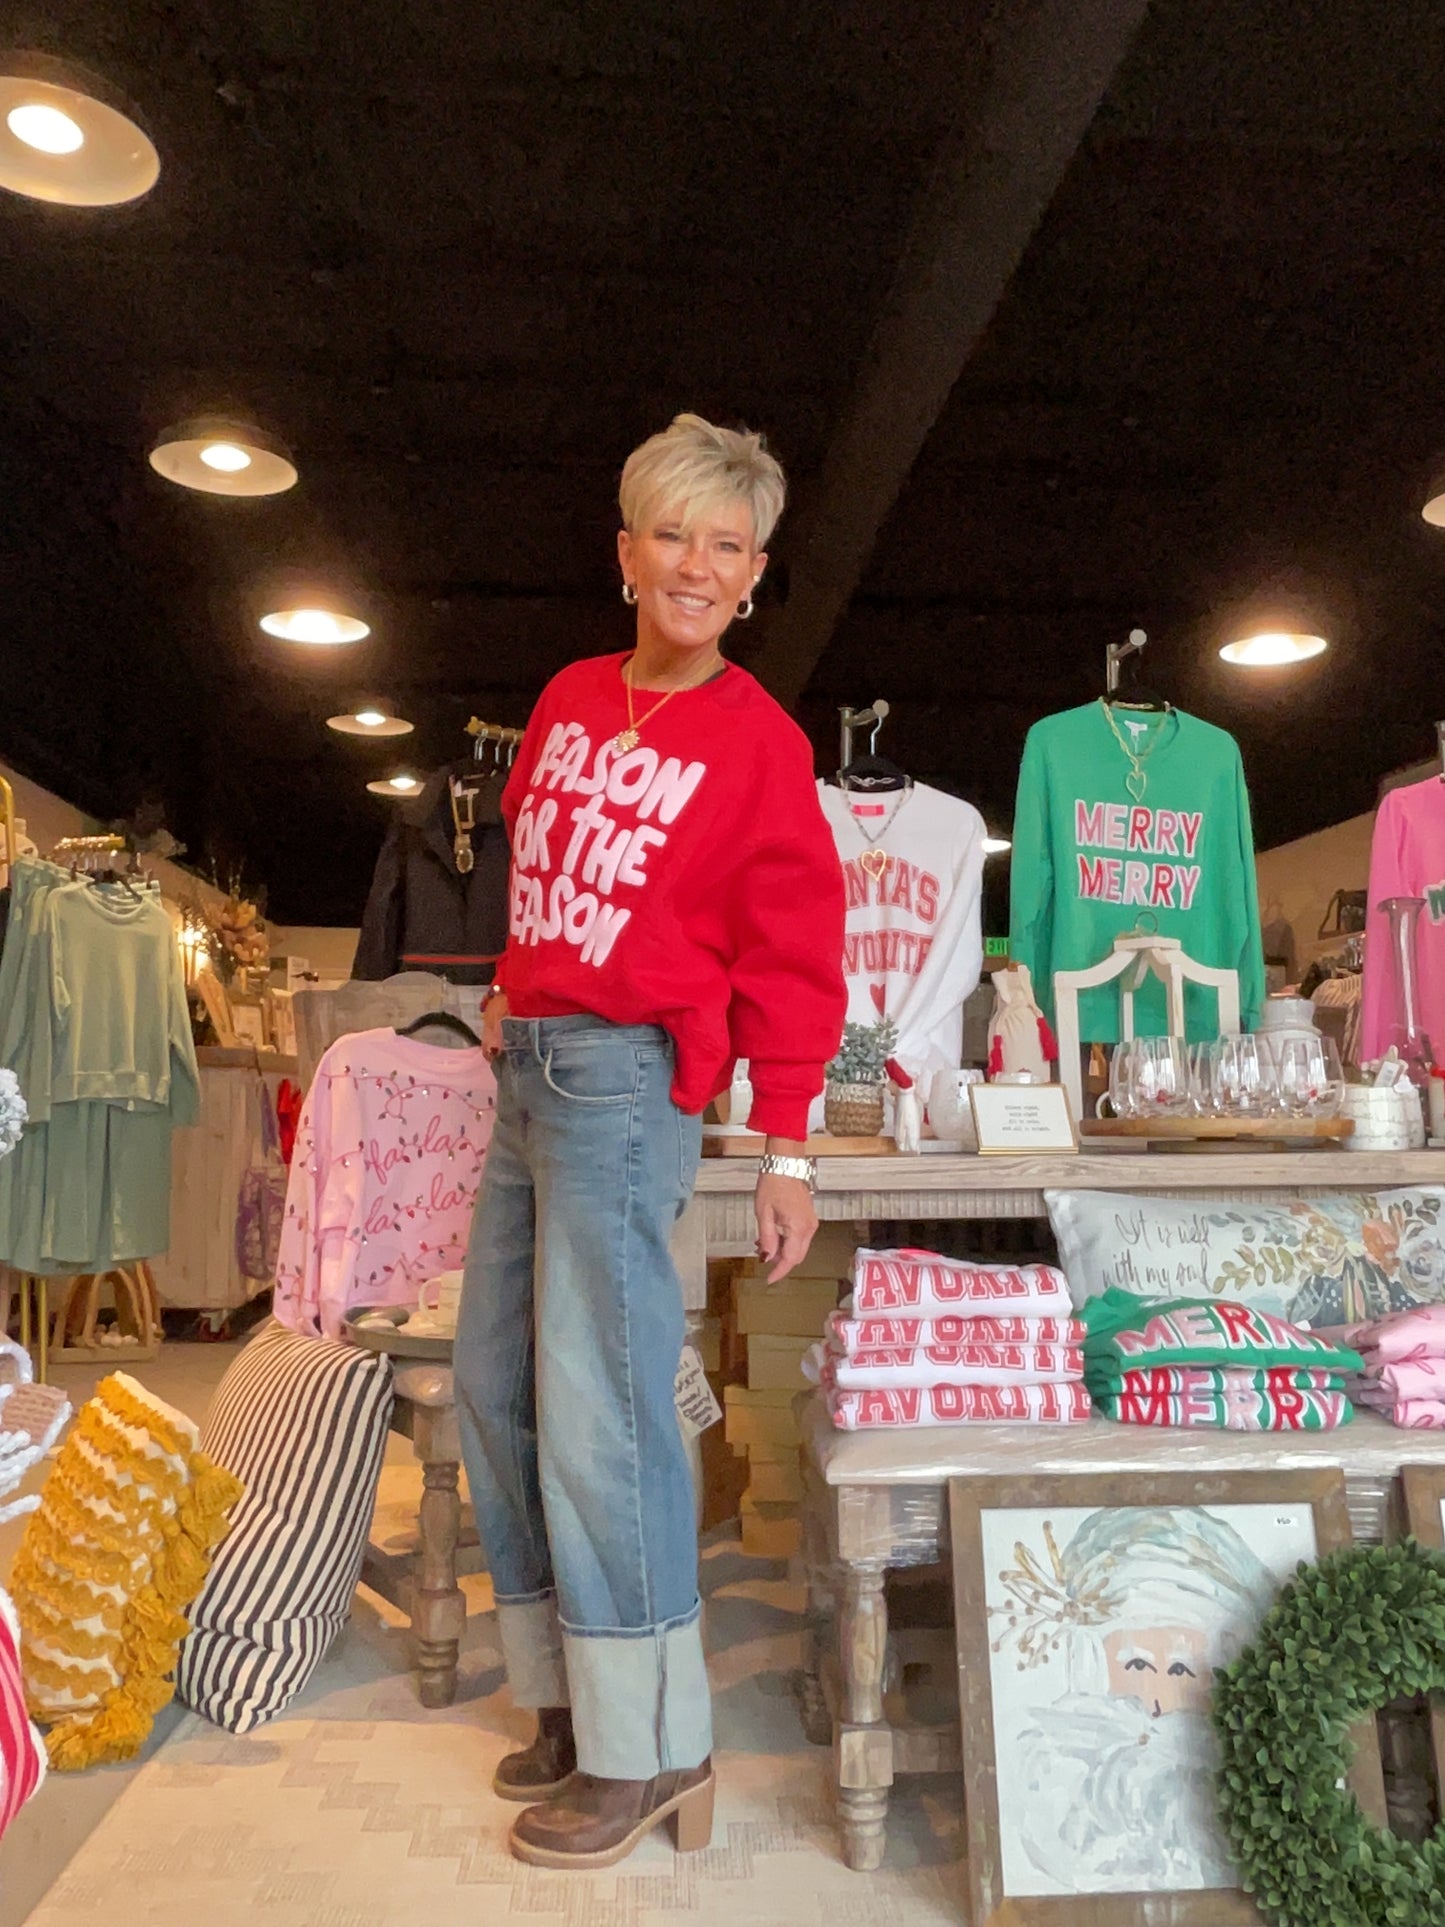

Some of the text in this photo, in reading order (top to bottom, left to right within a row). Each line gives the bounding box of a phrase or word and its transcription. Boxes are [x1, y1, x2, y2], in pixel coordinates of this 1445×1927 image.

[530, 721, 706, 825] REASON
[1075, 799, 1203, 857] MERRY
[1076, 853, 1202, 910] MERRY
[509, 863, 632, 968] EASON
[369, 1114, 453, 1186] fa la
[364, 1172, 463, 1235] la la
